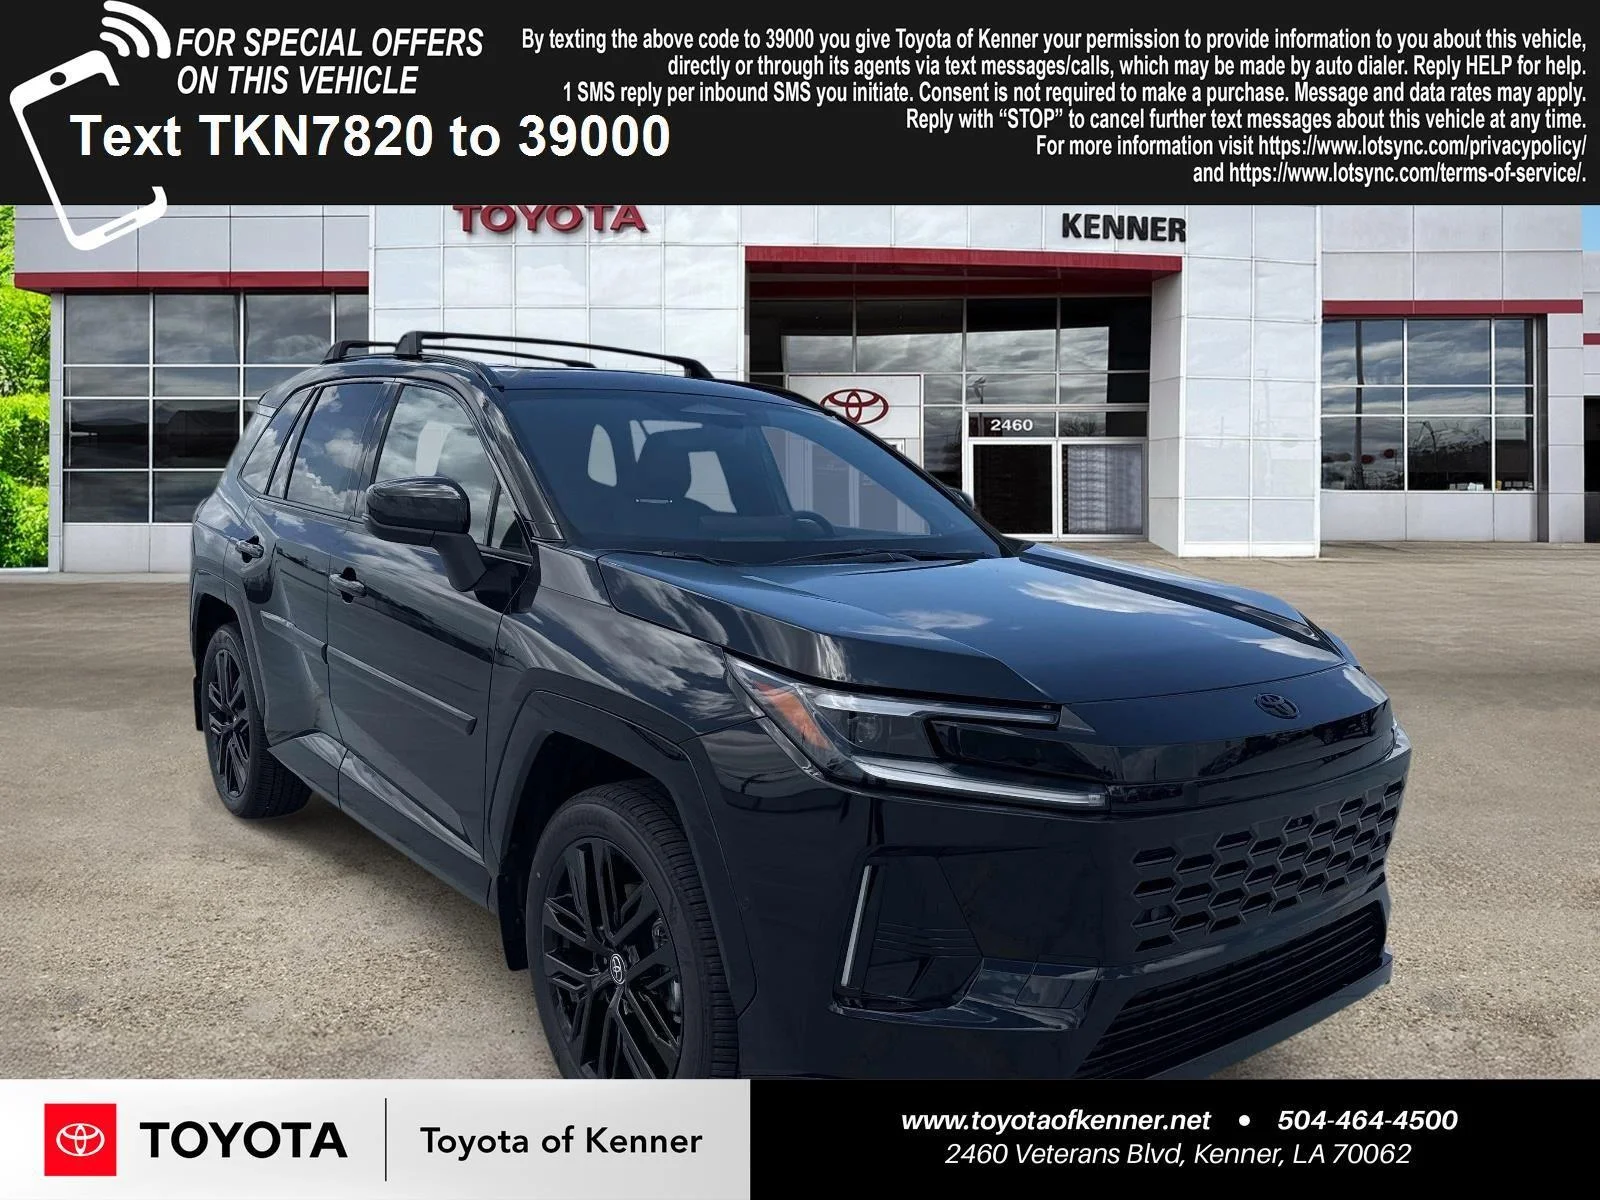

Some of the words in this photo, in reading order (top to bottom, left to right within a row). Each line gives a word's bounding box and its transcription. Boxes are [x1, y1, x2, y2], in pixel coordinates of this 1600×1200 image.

[453, 205, 647, 232] TOYOTA
[1062, 212, 1187, 243] KENNER
[990, 419, 1033, 431] 2460
